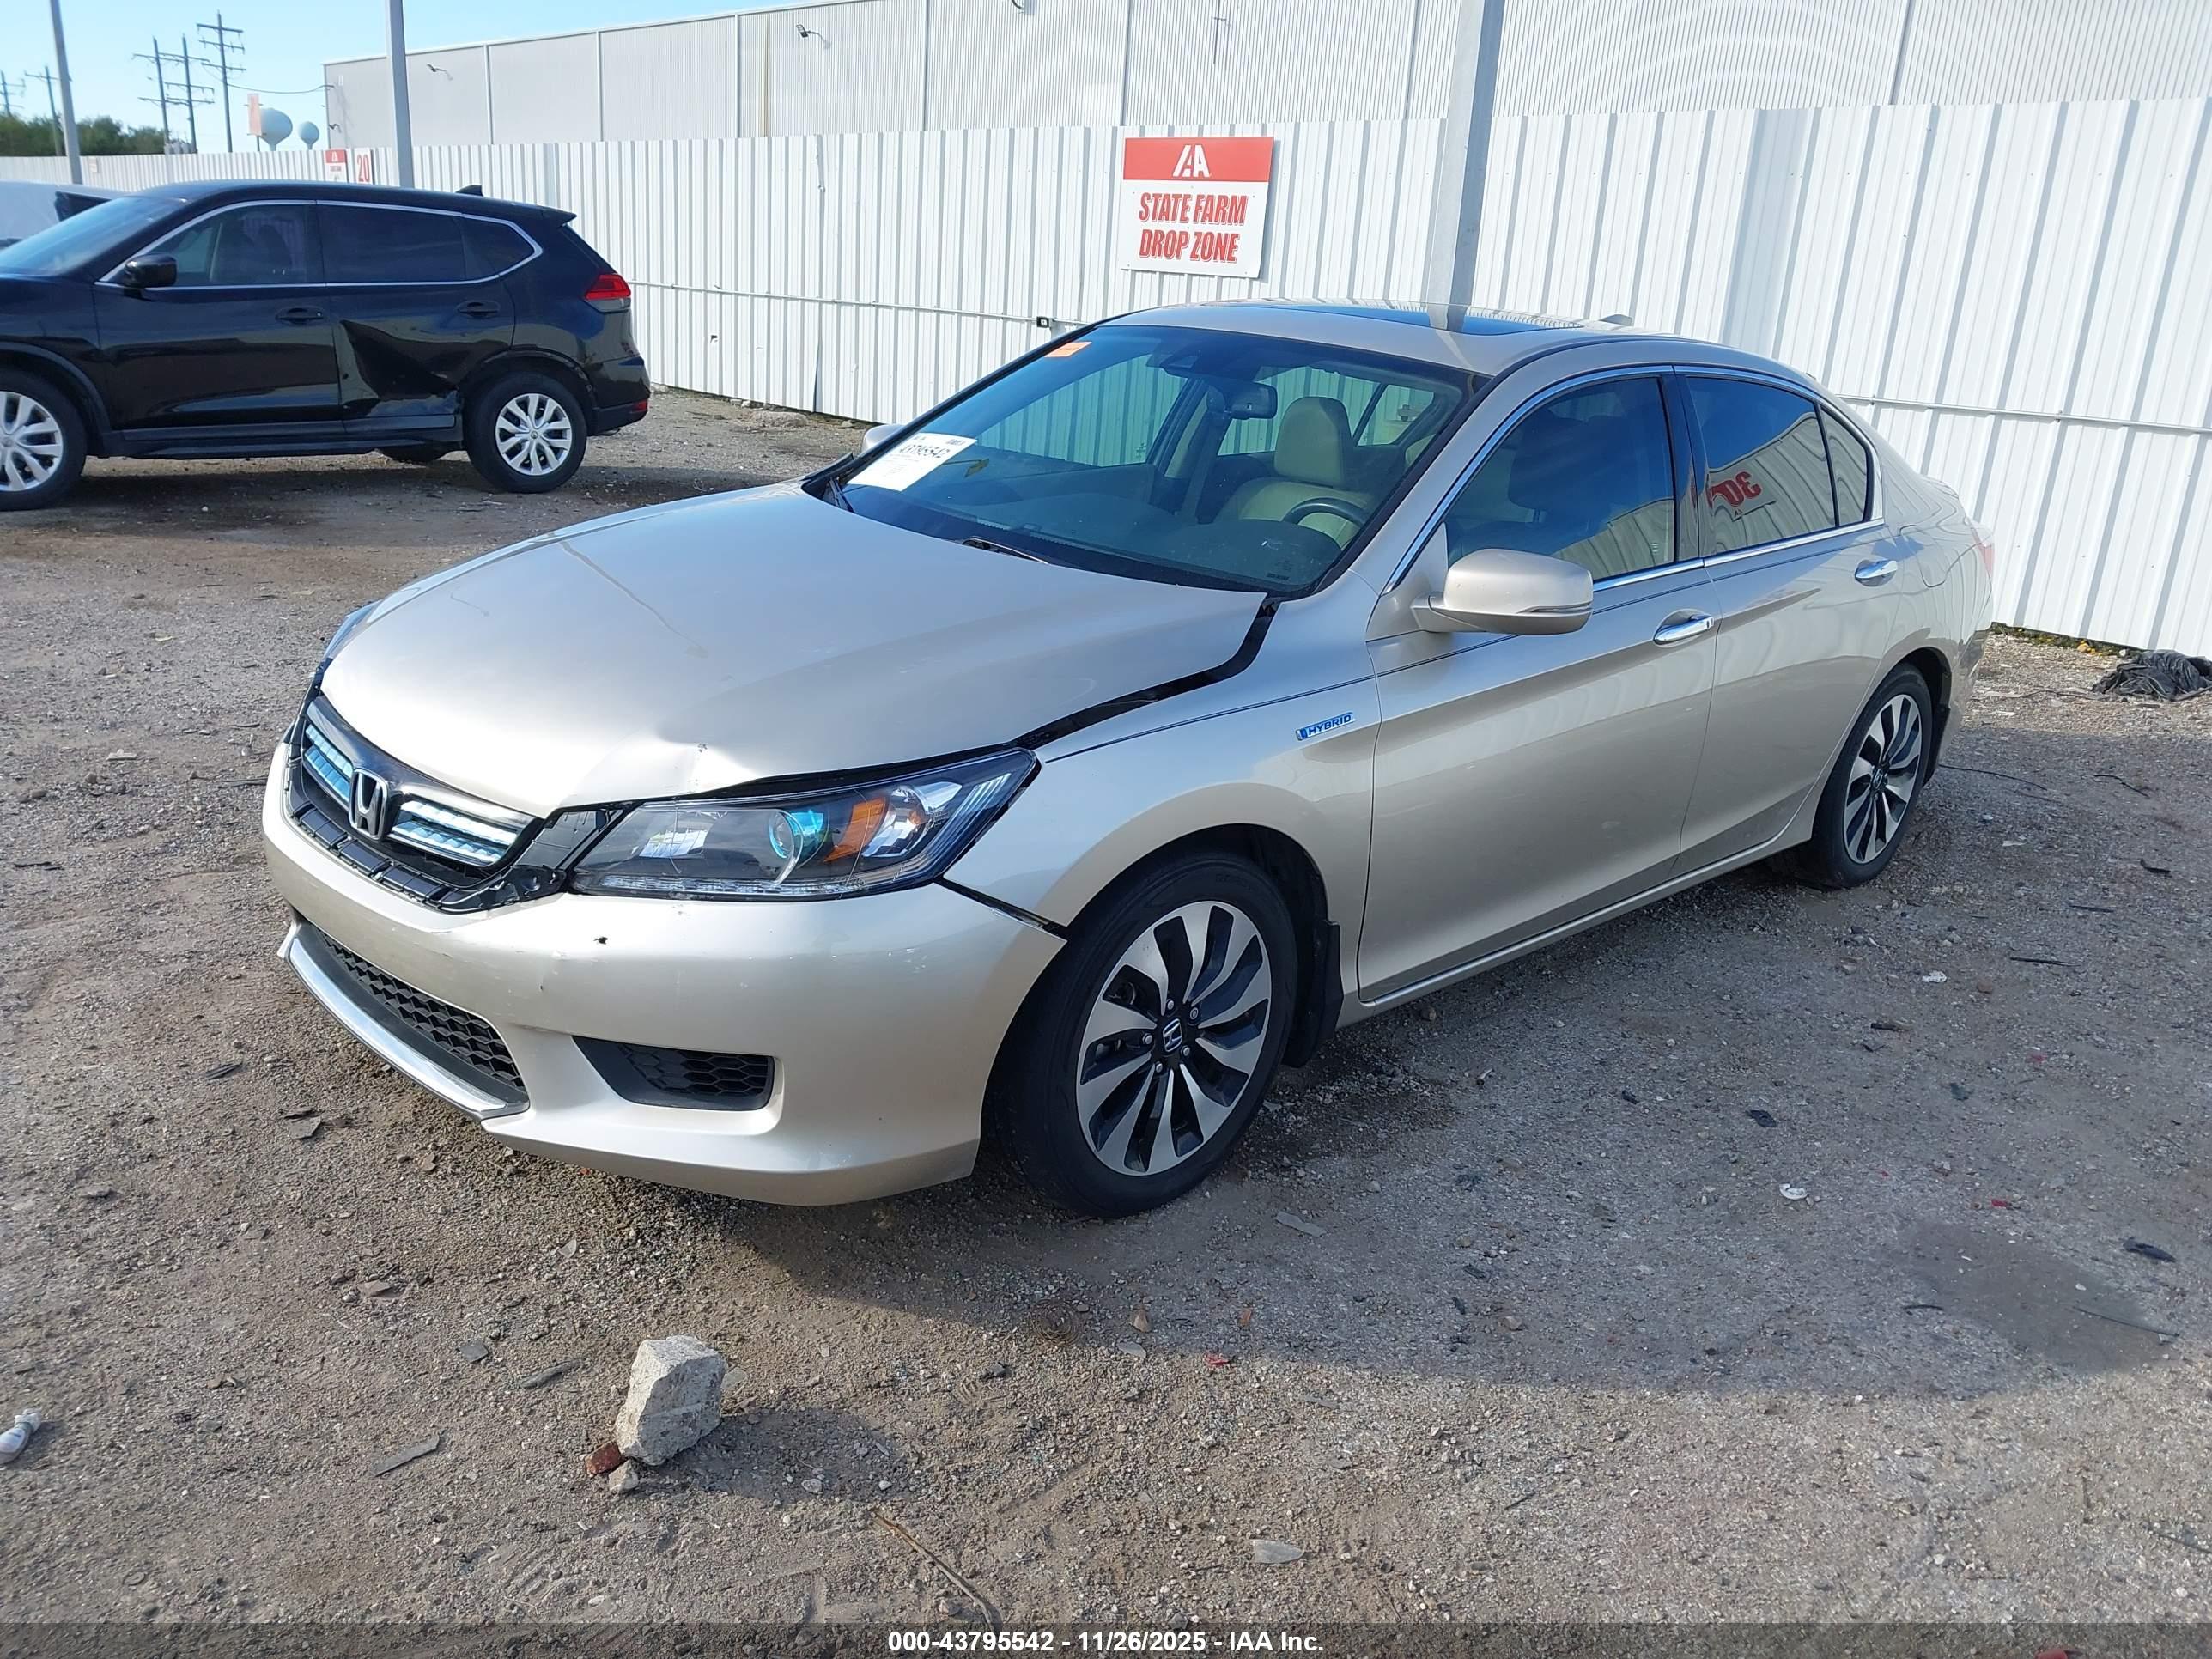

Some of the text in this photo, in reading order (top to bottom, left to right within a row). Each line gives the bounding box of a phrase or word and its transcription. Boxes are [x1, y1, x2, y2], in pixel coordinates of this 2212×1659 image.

[356, 154, 371, 183] 20
[1139, 192, 1249, 226] STATE FARM
[1139, 228, 1241, 264] DROP ZONE
[1308, 714, 1352, 736] HYBRID
